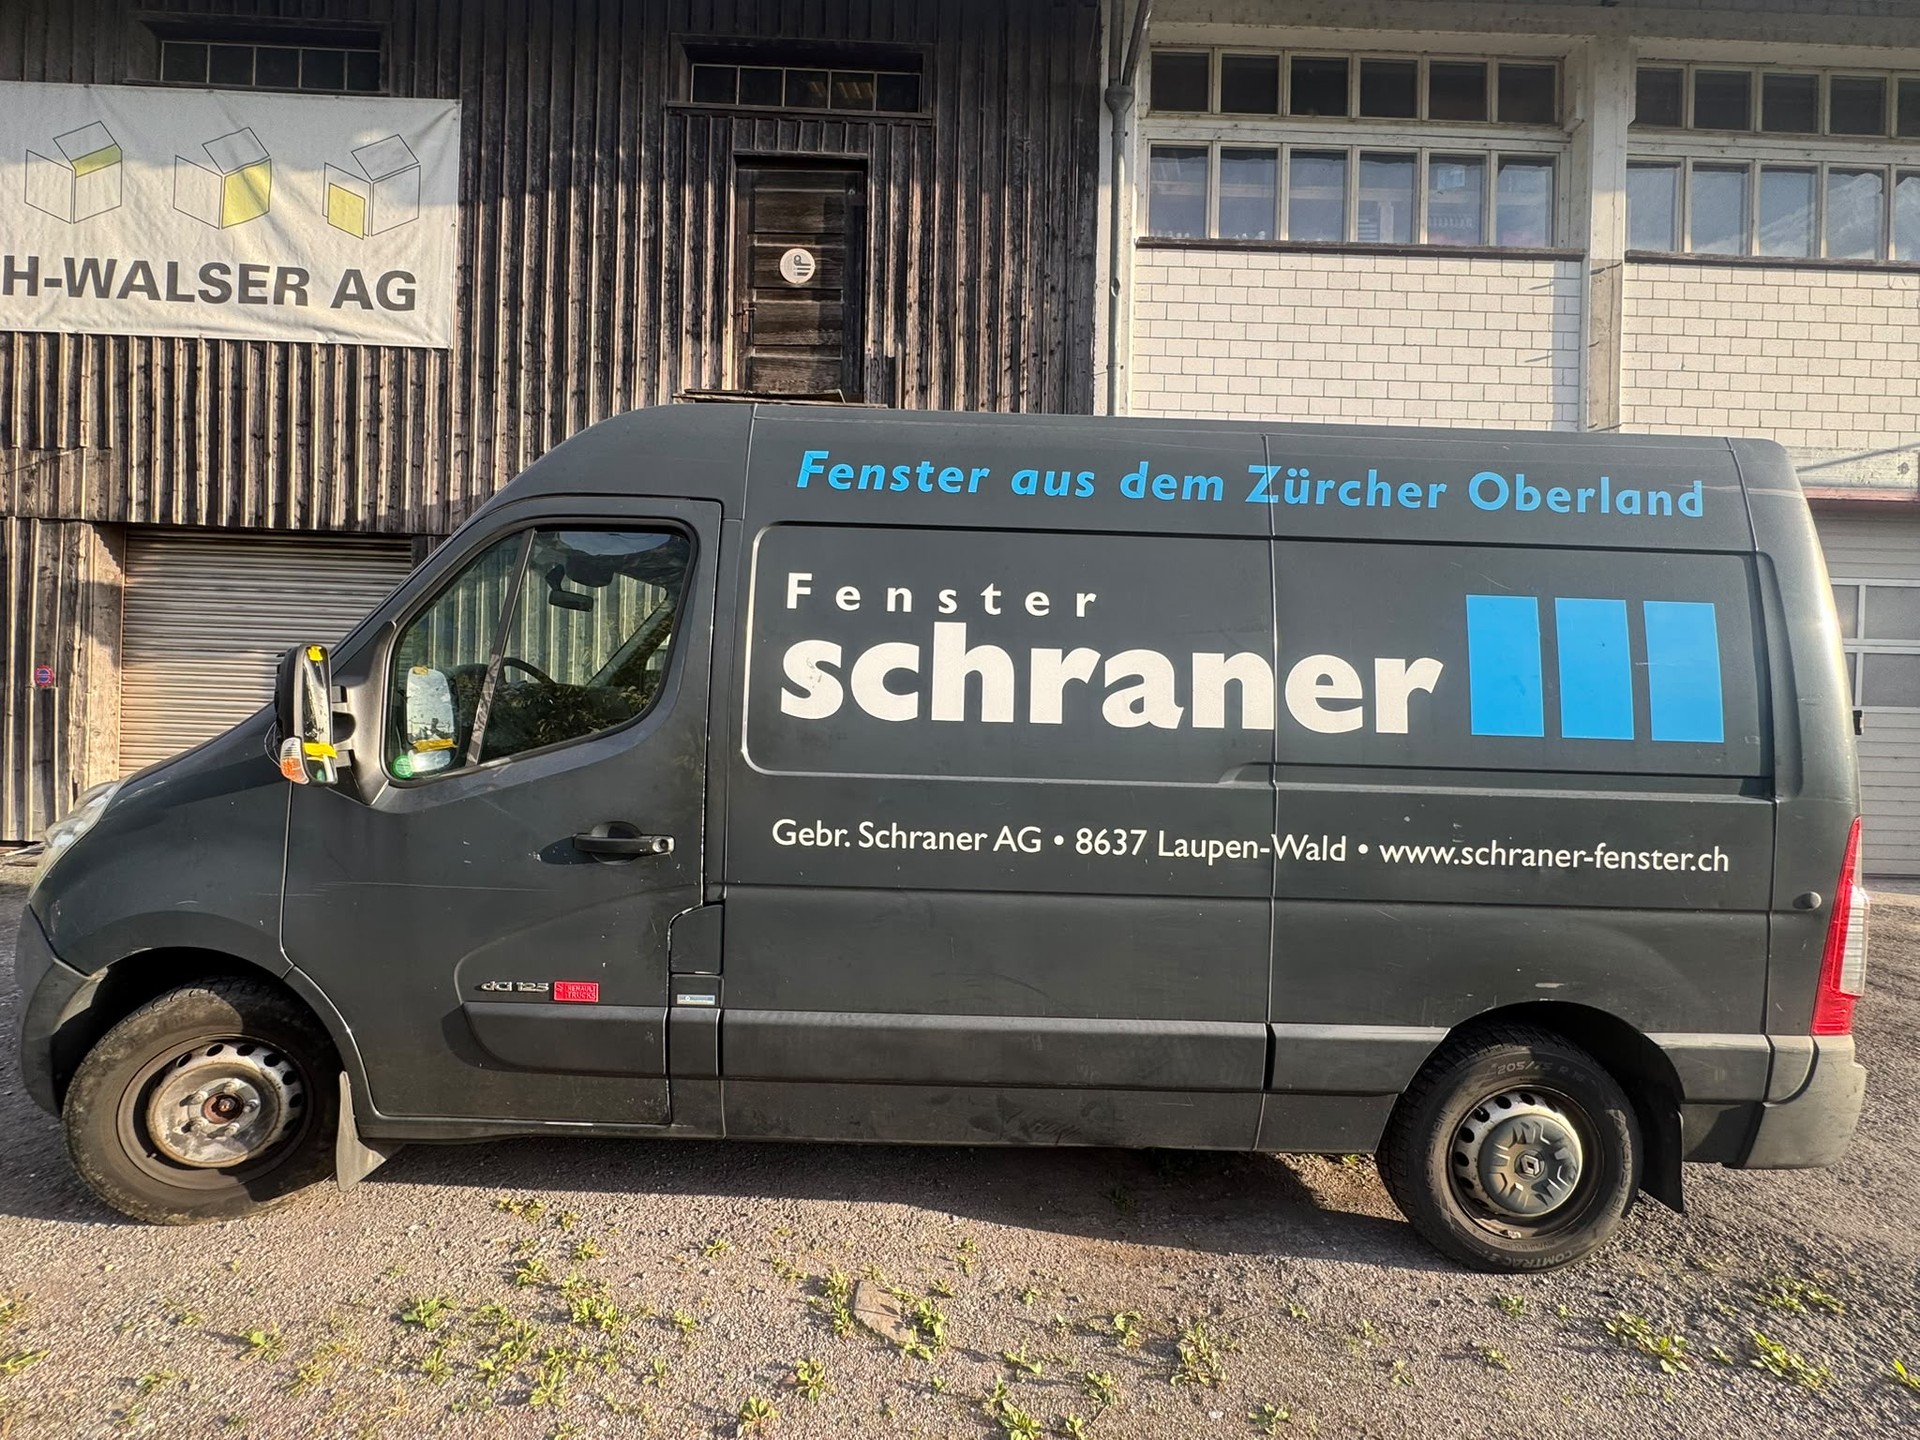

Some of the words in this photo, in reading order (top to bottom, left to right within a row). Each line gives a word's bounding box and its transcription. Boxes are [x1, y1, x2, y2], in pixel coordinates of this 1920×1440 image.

[2, 255, 310, 307] H-WALSER
[330, 268, 416, 312] AG
[796, 449, 991, 494] Fenster
[1010, 468, 1096, 498] aus
[1119, 460, 1225, 502] dem
[1246, 464, 1447, 509] Zürcher
[1468, 471, 1703, 517] Oberland
[786, 572, 1097, 618] Fenster
[780, 621, 1444, 735] schraner
[772, 818, 851, 848] Gebr.
[858, 820, 989, 852] Schraner
[992, 825, 1042, 853] AG
[1075, 827, 1148, 856] 8637
[1158, 830, 1347, 866] Laupen-Wald
[1378, 839, 1729, 873] www.schraner-fenster.ch
[516, 981, 550, 993] 125
[567, 991, 596, 1000] TRUCKS
